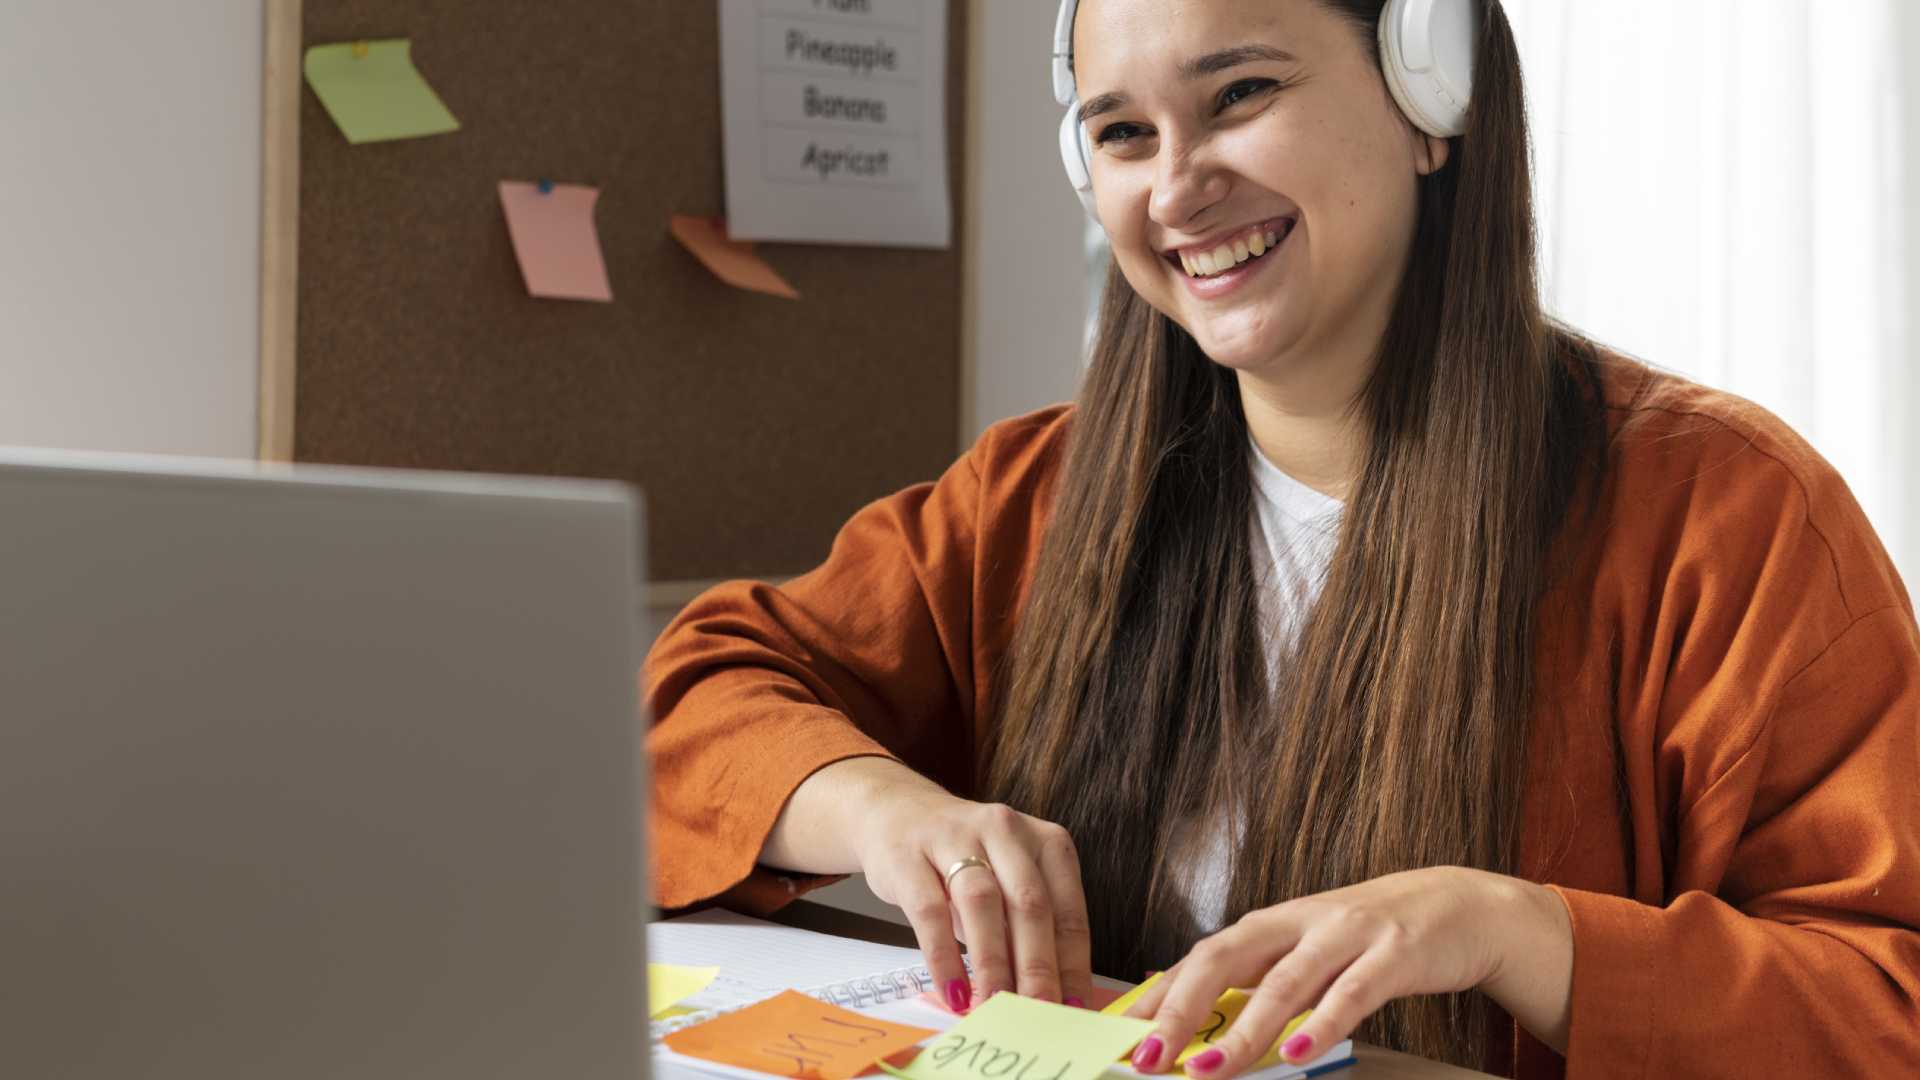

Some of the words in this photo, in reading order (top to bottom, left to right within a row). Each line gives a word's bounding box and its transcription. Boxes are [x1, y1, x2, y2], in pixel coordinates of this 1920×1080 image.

[785, 29, 897, 77] Pineapple
[804, 85, 887, 123] Banana
[801, 142, 888, 181] Apricot
